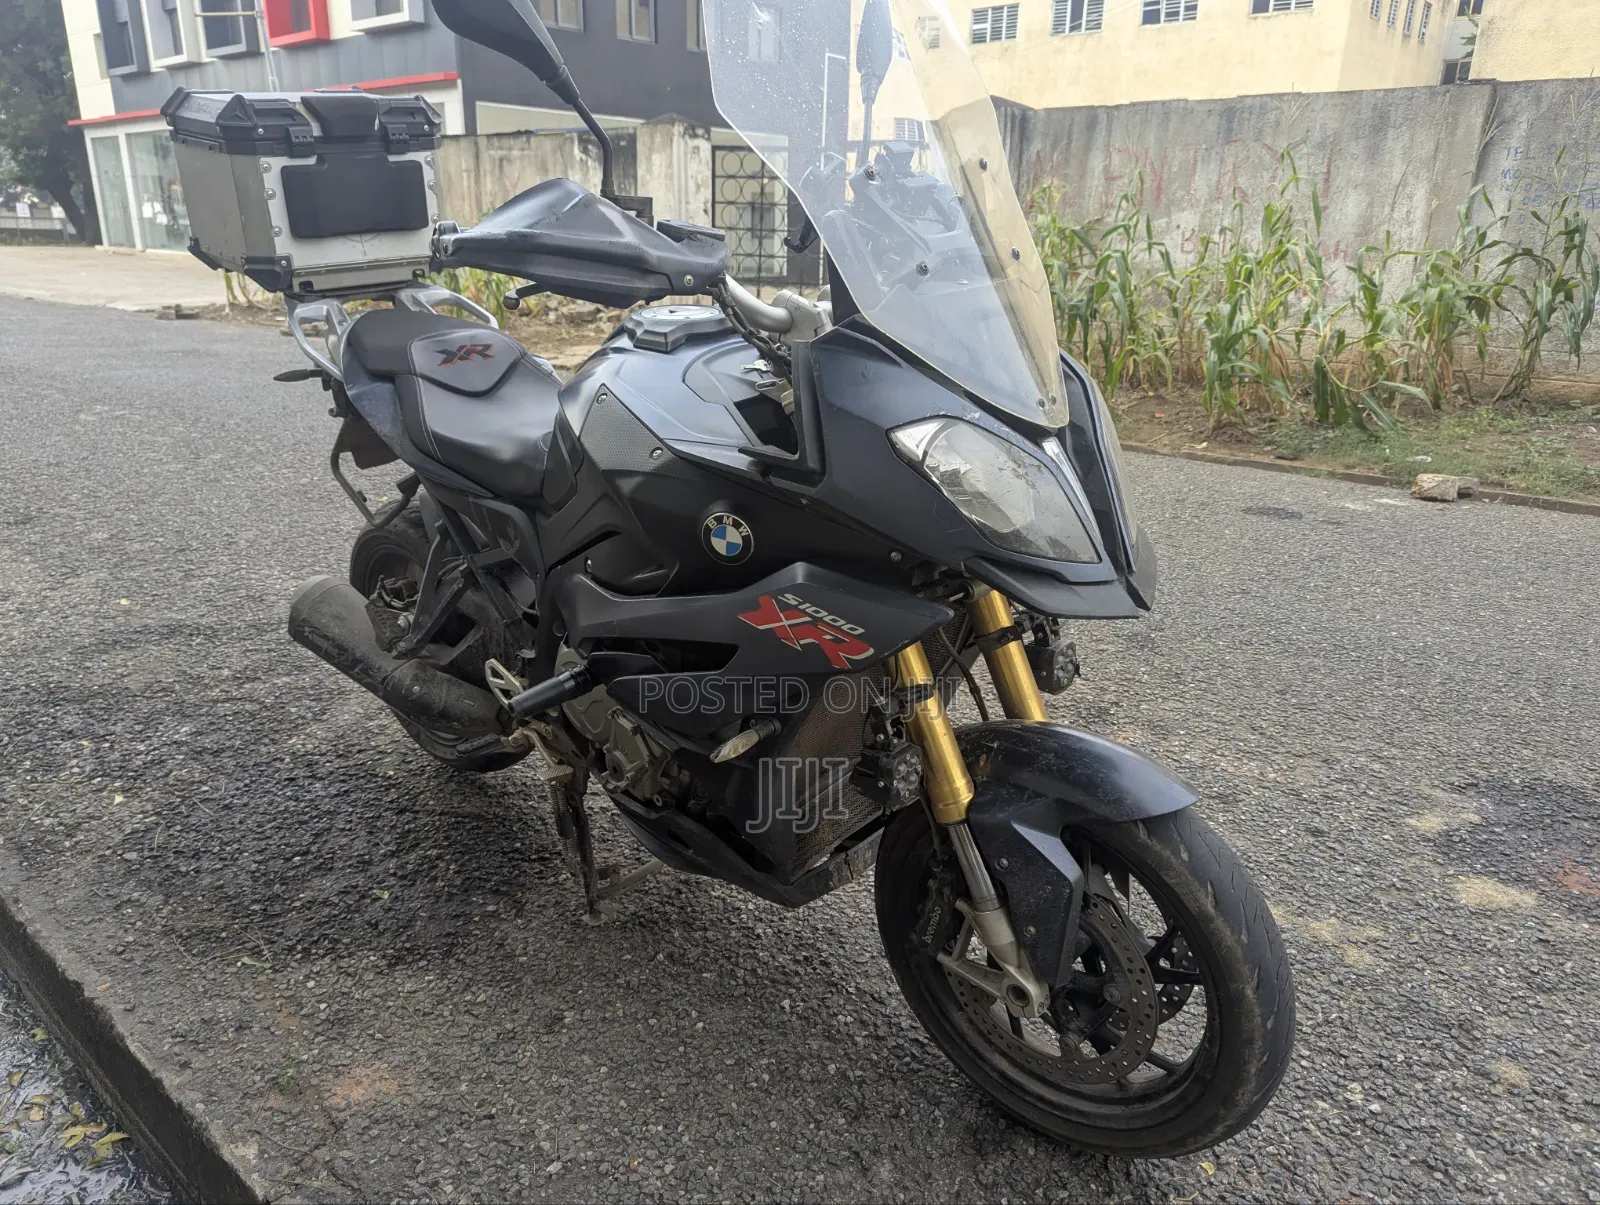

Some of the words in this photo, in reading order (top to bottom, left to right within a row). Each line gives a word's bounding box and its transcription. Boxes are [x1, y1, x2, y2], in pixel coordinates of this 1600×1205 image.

[433, 343, 495, 367] XR
[707, 515, 750, 537] BMW
[737, 594, 875, 669] XR
[777, 593, 866, 635] S1000
[921, 906, 942, 944] brembo
